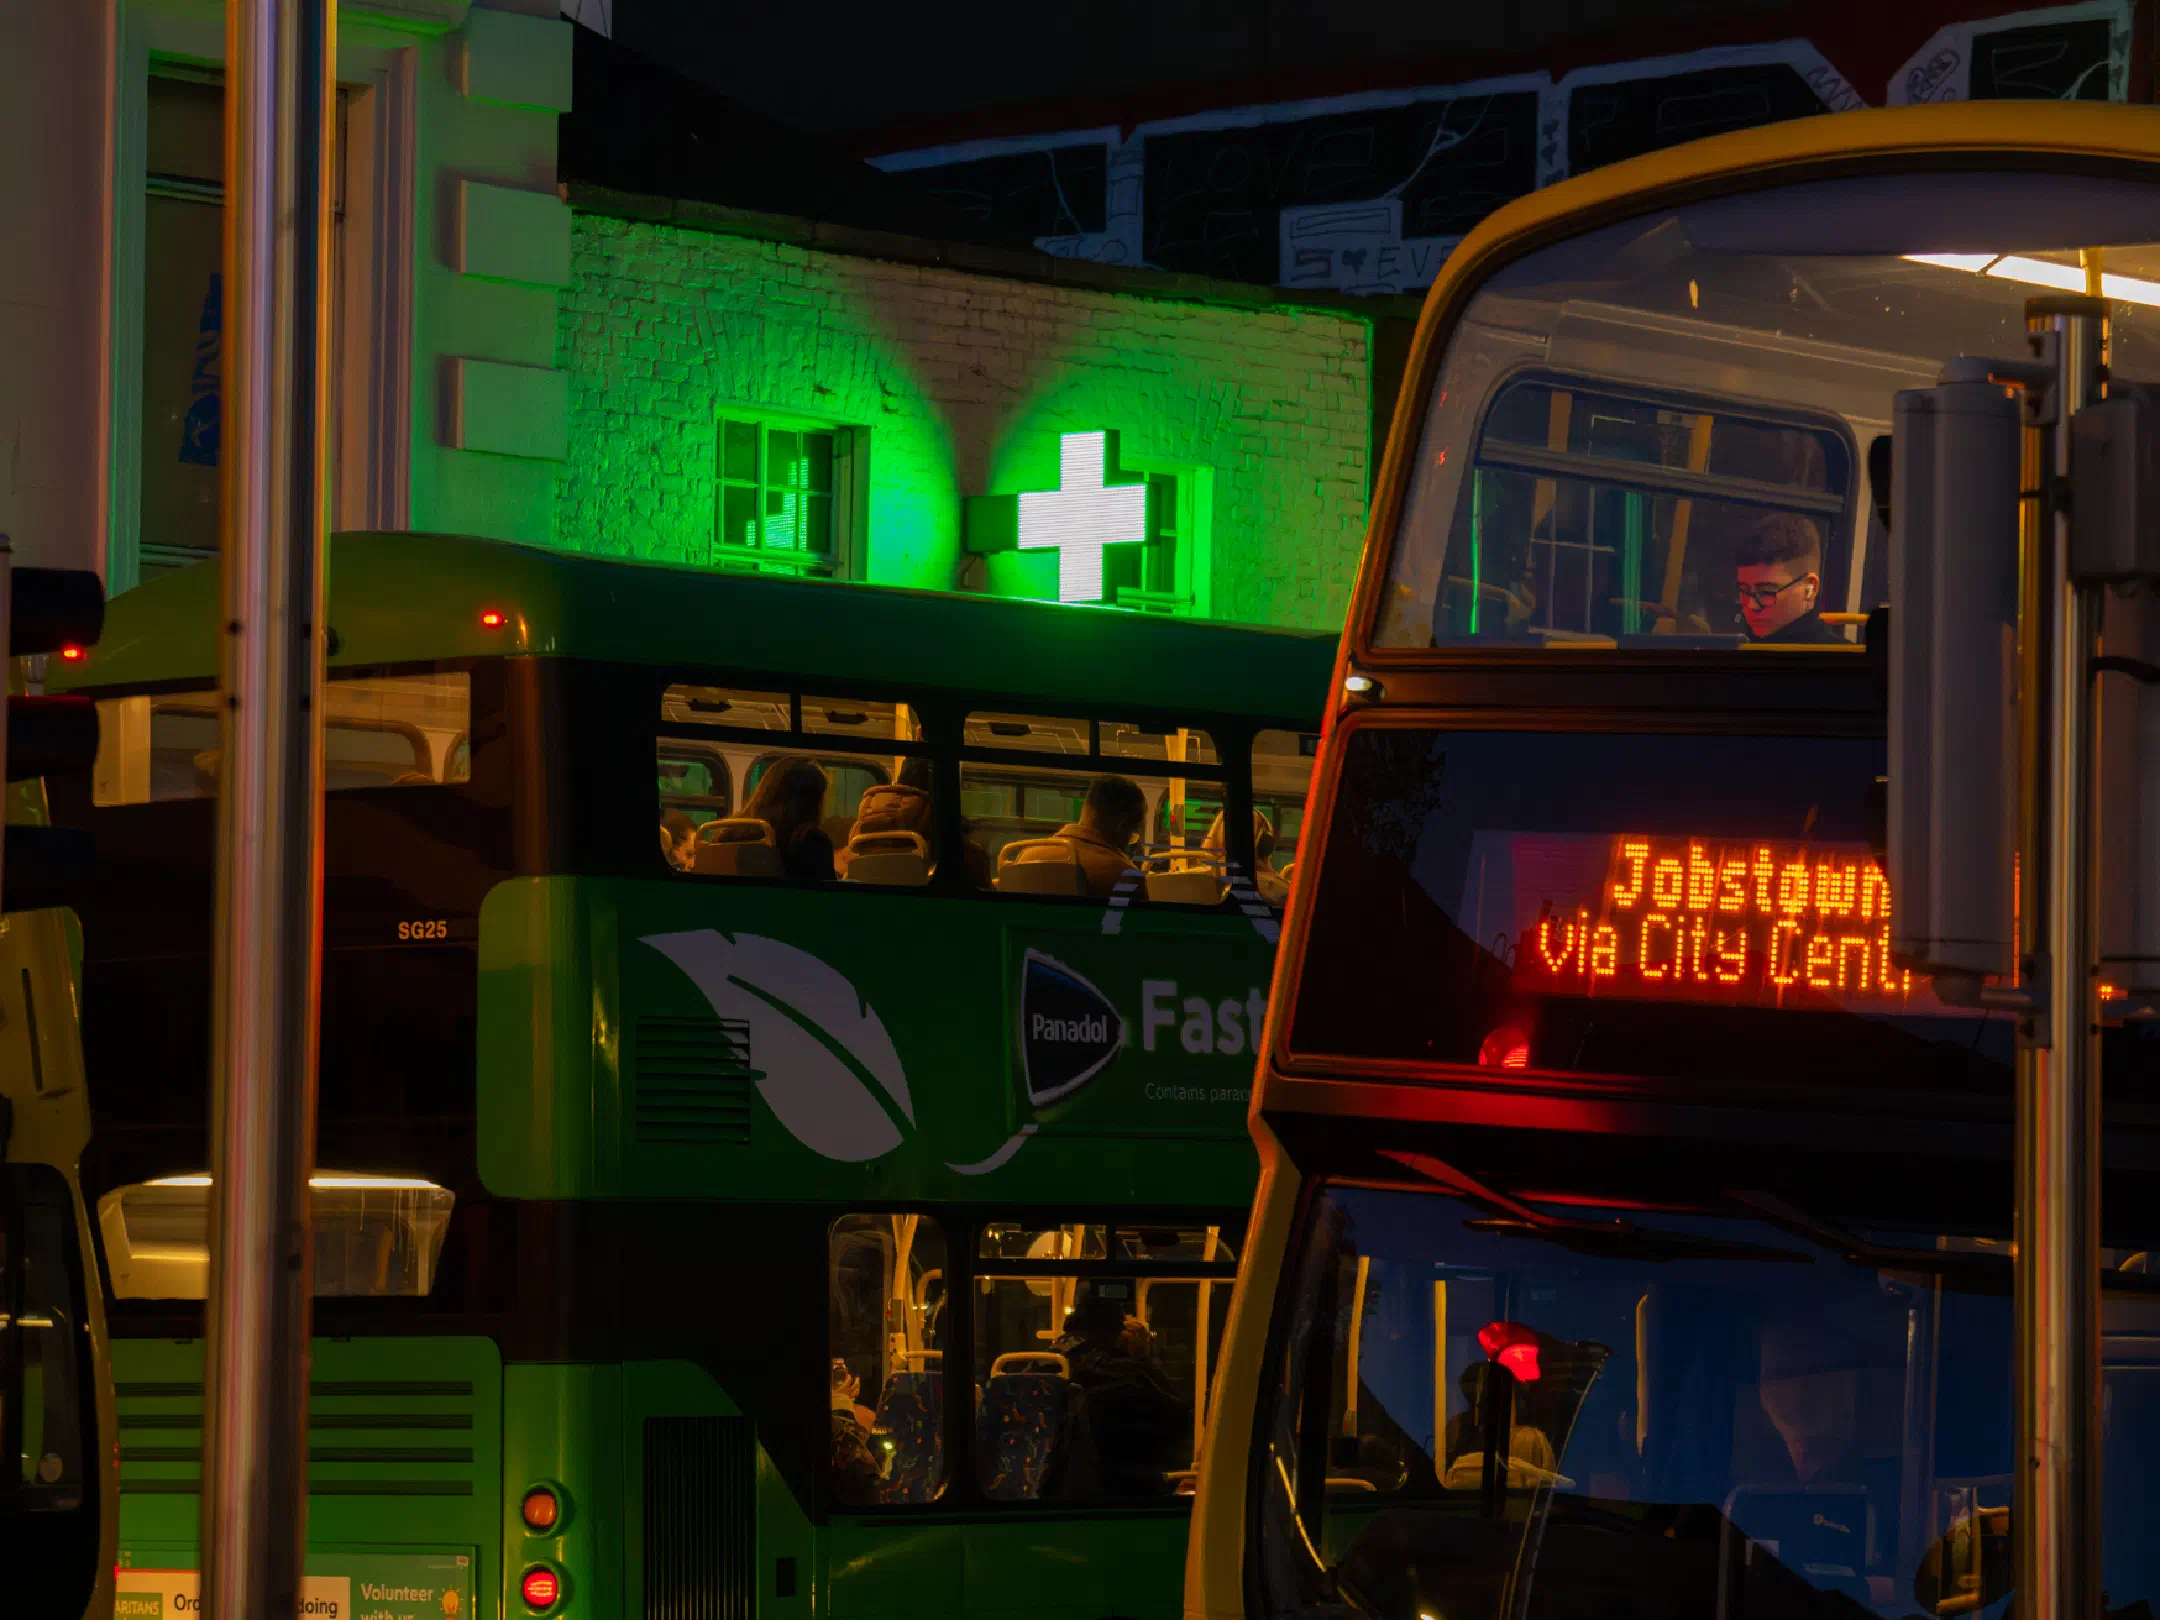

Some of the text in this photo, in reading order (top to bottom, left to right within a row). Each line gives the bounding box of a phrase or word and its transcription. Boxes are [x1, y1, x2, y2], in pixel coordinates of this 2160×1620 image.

[1613, 843, 1892, 917] Jobstown
[397, 919, 449, 941] SG25
[1540, 910, 1911, 992] via City Cent
[1032, 1011, 1109, 1044] Panadol
[1142, 978, 1268, 1056] Fast
[1144, 1081, 1206, 1101] Contains
[360, 1583, 434, 1602] Volunteer
[296, 1597, 338, 1619] doing
